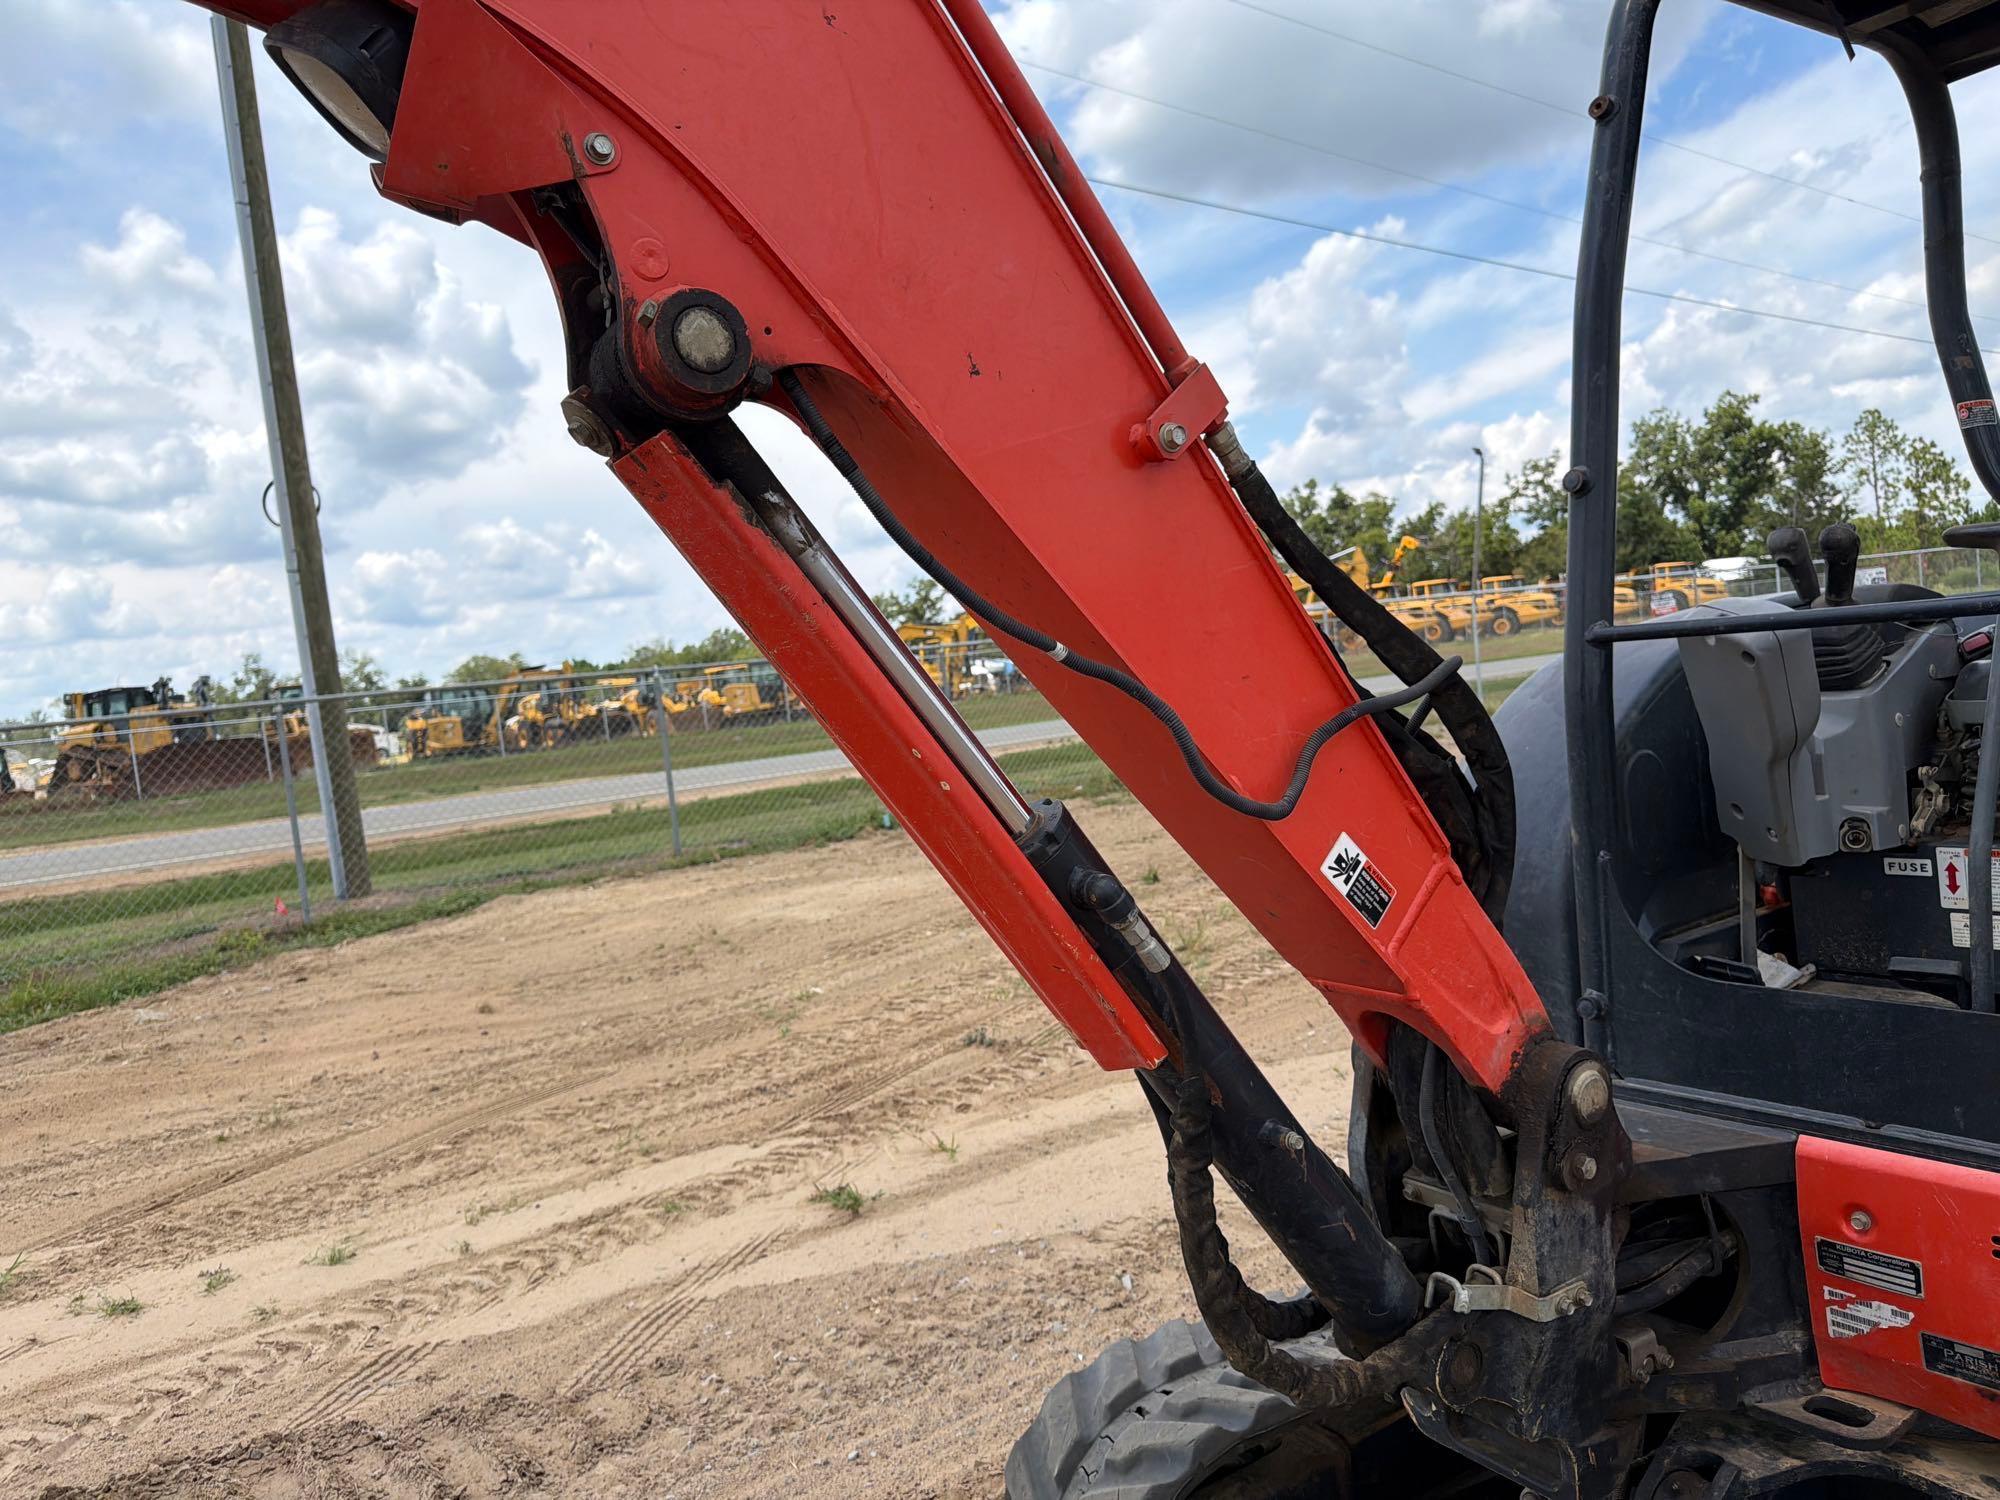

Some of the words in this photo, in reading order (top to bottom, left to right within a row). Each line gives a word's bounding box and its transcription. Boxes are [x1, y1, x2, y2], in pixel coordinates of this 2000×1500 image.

[1888, 862, 1929, 873] FUSE
[1836, 1244, 1866, 1257] KUBOTA
[1867, 1252, 1911, 1268] Corporation
[1943, 1348, 1998, 1372] PARISH
